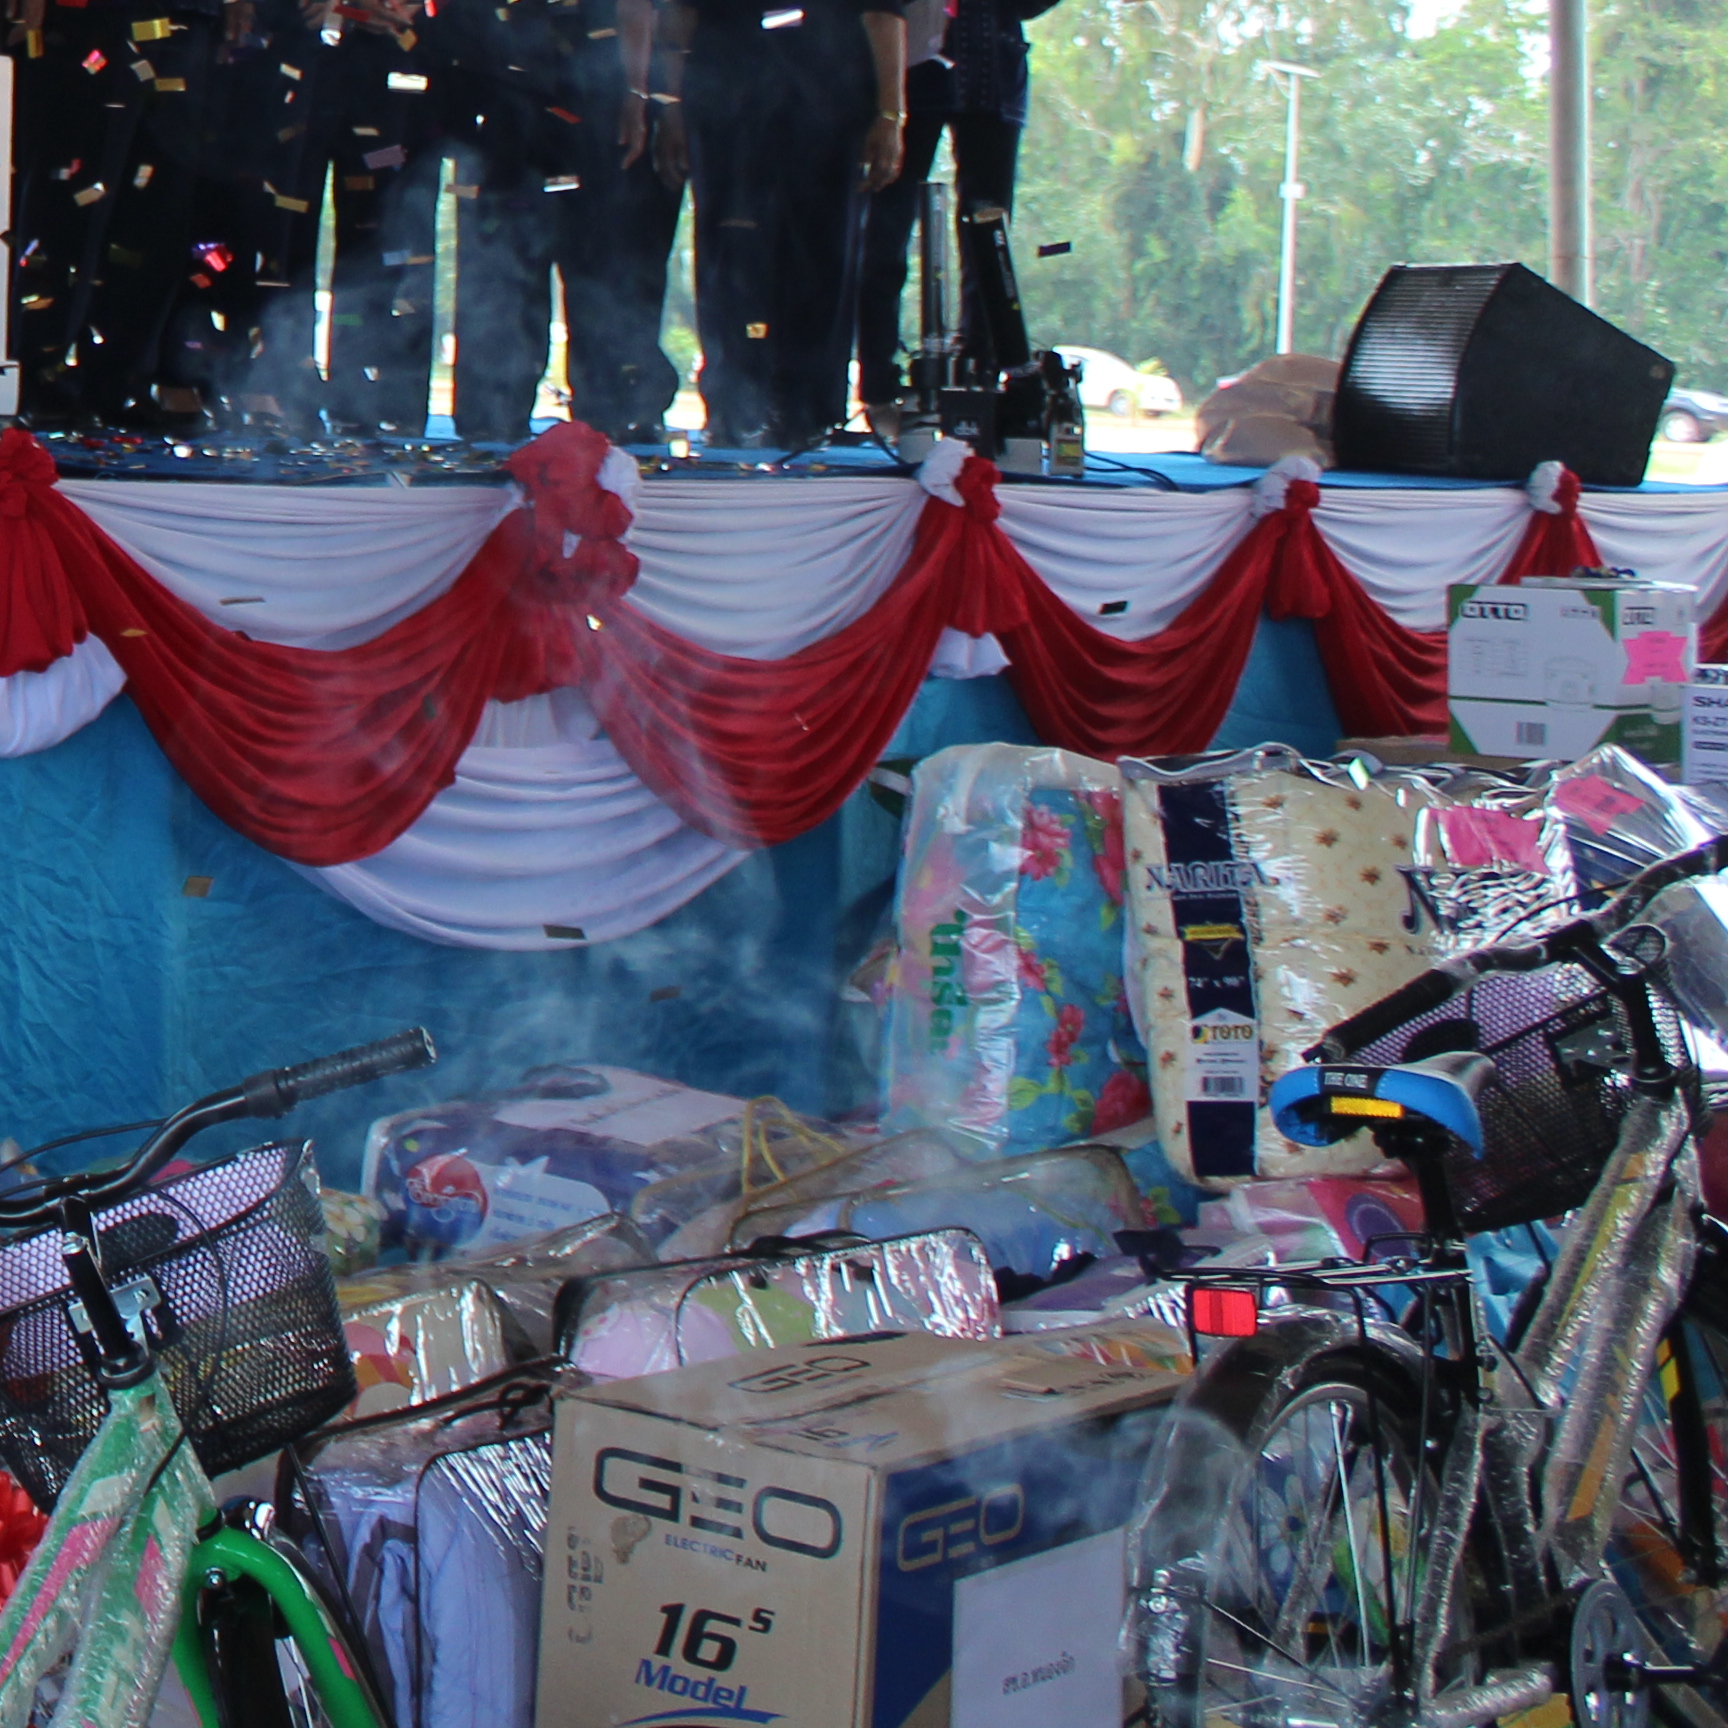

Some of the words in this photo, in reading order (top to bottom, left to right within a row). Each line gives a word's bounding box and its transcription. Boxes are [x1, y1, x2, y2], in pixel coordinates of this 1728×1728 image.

[593, 1446, 843, 1560] GEO
[897, 1482, 1026, 1573] GEO
[634, 1657, 748, 1710] Model
